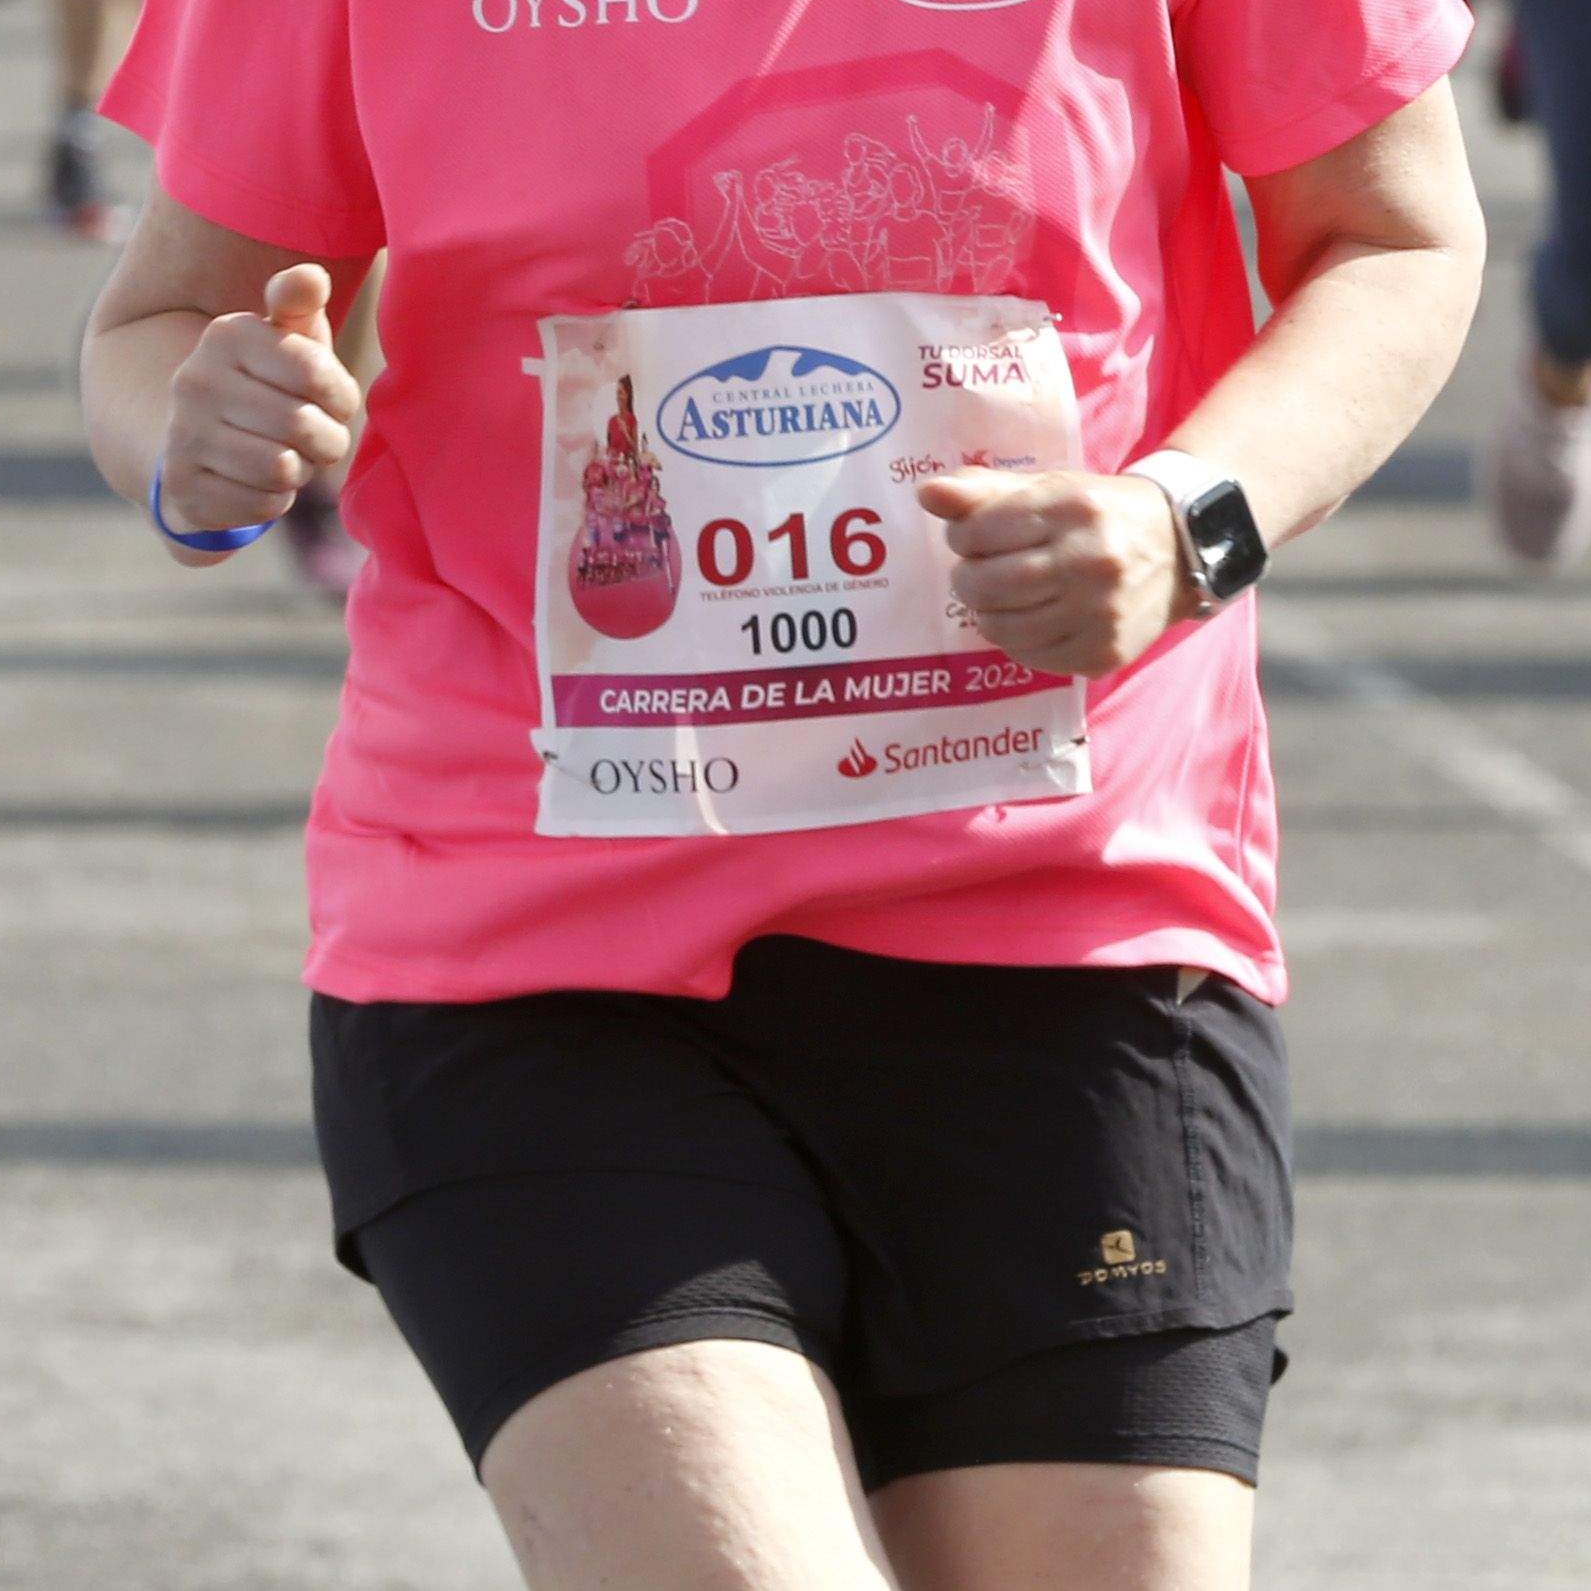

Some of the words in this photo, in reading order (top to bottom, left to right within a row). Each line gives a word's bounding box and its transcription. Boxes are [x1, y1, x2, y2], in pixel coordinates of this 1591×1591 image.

[918, 345, 943, 360] TU
[948, 344, 1024, 360] DORSAL
[712, 387, 790, 404] CENTRAL
[799, 381, 875, 398] LECHERA
[922, 361, 1026, 389] SUMA
[676, 395, 885, 442] ASTURIANA
[696, 506, 888, 587] 016
[763, 583, 823, 597] VIOLENCIA
[825, 581, 839, 593] DE
[741, 606, 858, 656] 1000
[599, 686, 732, 714] CARRERA
[741, 681, 787, 709] DE
[795, 677, 835, 706] LA
[844, 668, 951, 702] MUJER
[883, 726, 1043, 774] Santander
[590, 757, 739, 795] OYSHO
